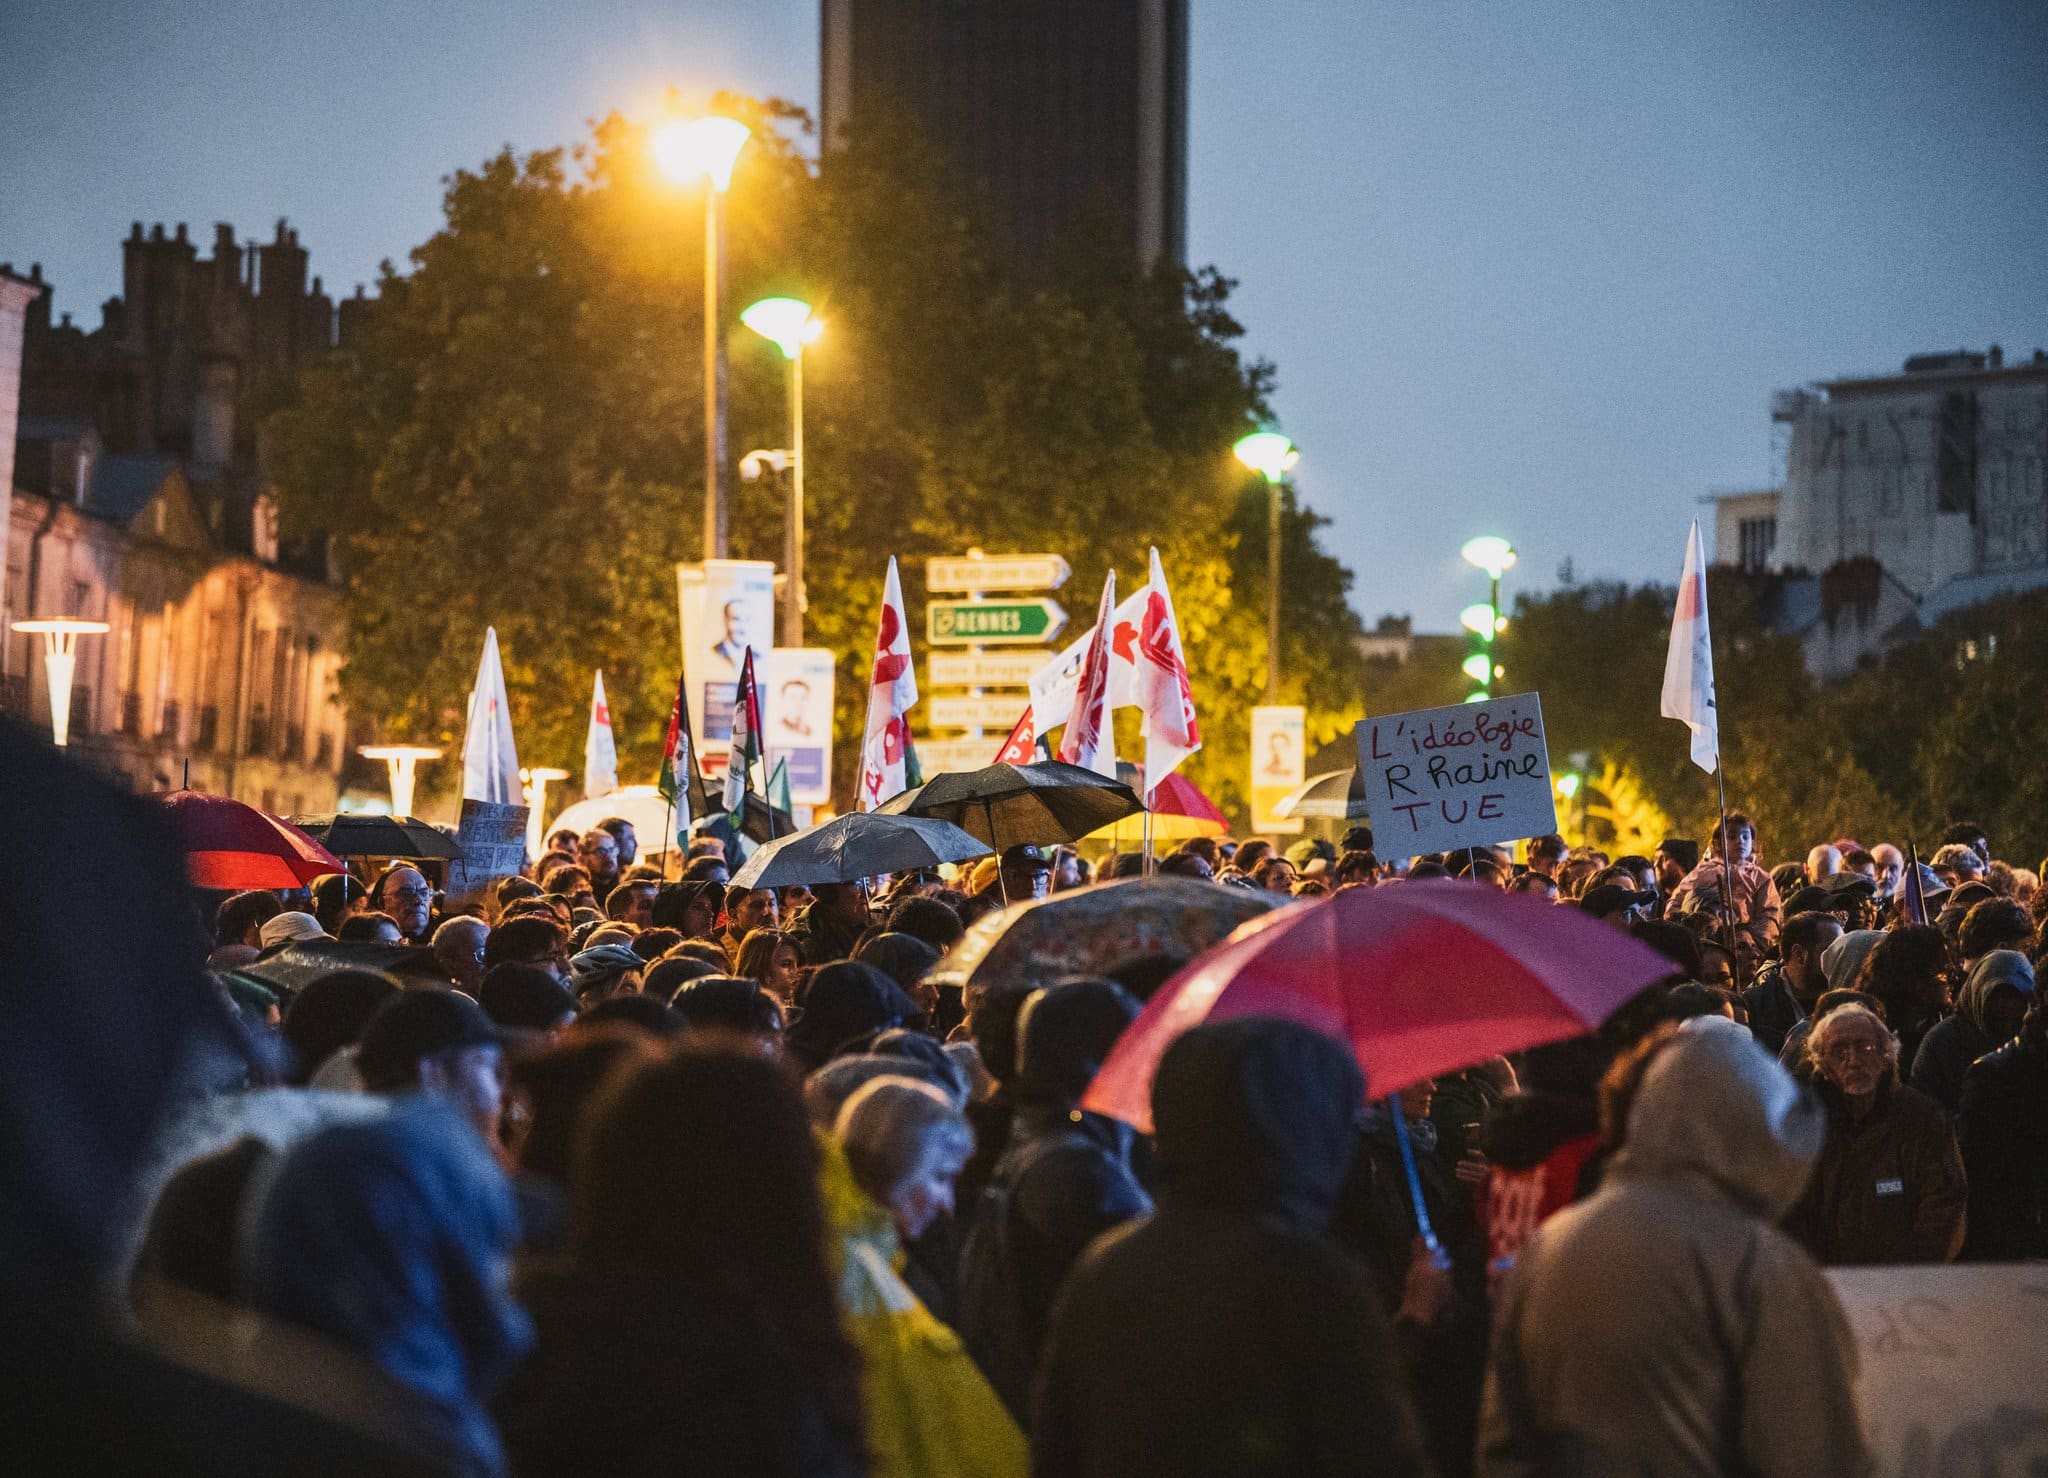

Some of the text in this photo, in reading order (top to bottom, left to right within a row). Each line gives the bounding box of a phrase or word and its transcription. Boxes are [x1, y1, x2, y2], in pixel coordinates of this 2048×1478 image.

[957, 611, 1021, 632] RENNES
[1371, 709, 1540, 760] L'idéologie
[1385, 752, 1544, 800] R haine
[1392, 793, 1505, 832] TUE
